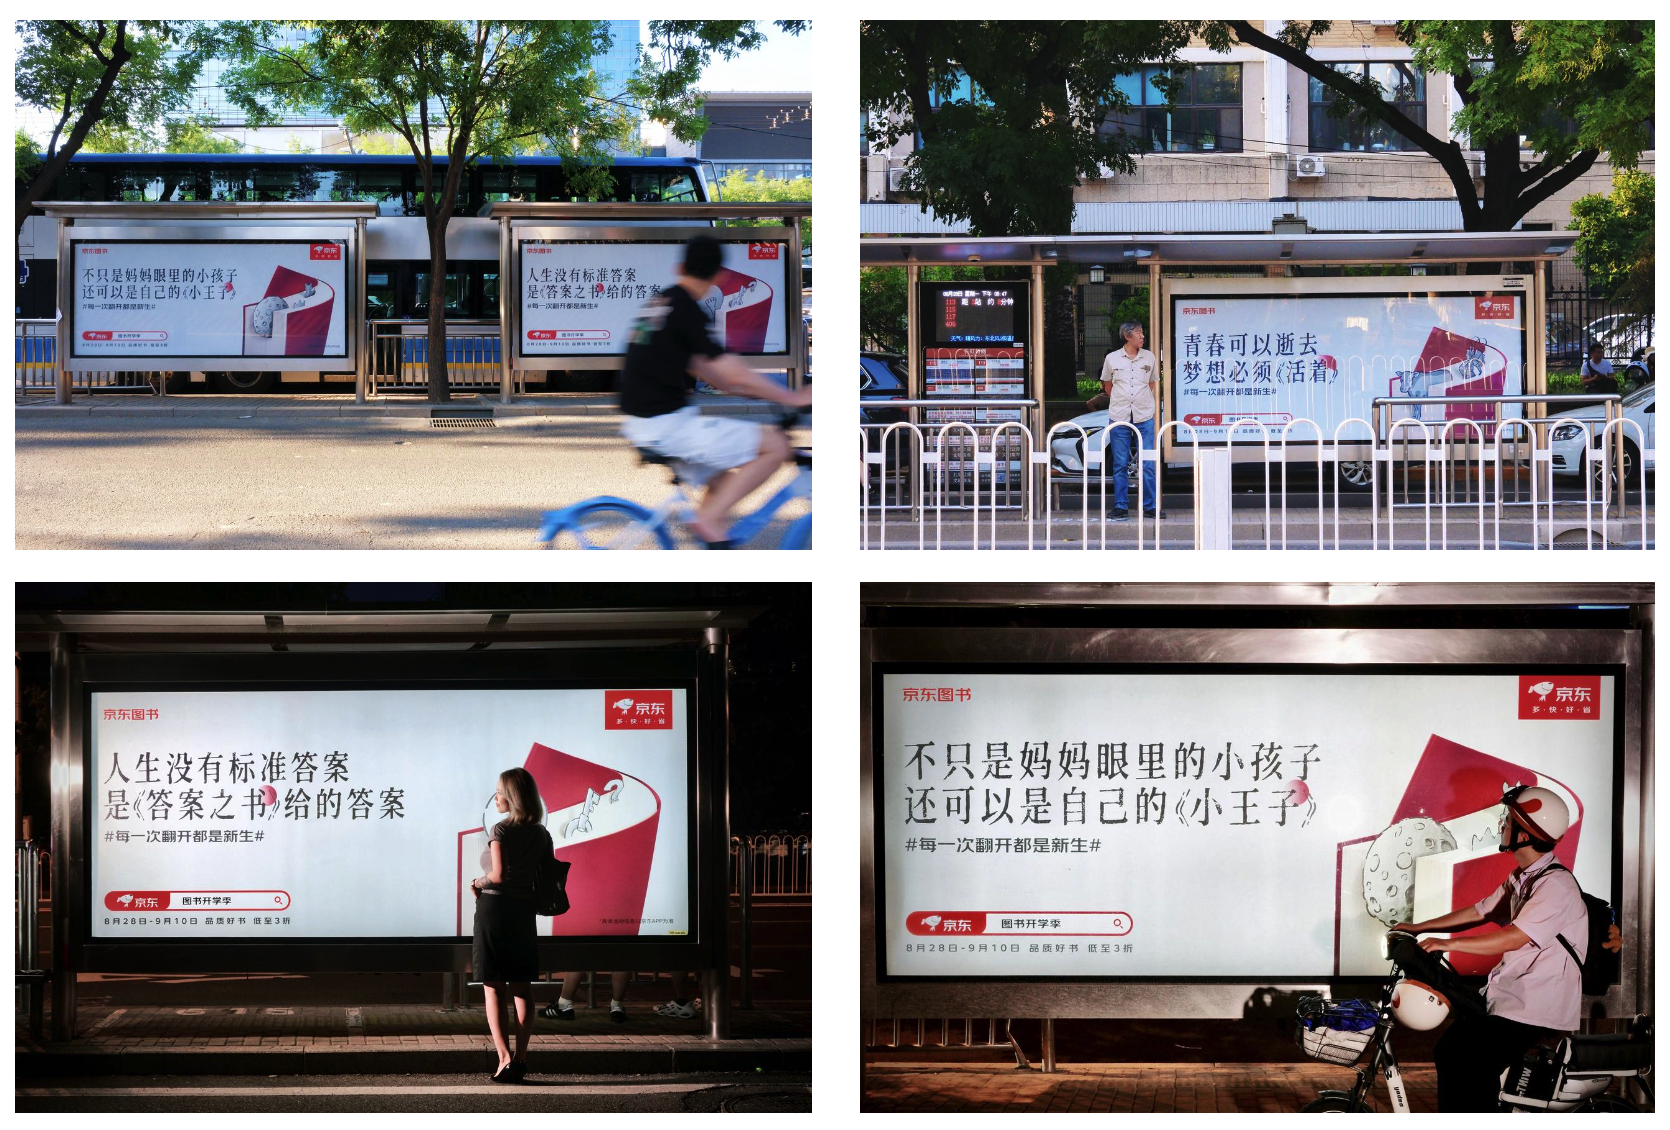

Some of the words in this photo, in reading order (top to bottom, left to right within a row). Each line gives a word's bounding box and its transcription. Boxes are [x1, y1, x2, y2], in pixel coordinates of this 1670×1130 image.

[82, 268, 238, 283] 不只是妈妈眼里的小孩子
[527, 267, 637, 283] 人生没有标准答案
[82, 284, 236, 300] 还可以是自己的《小王子》
[527, 284, 661, 300] 是《答案之书》给的答案
[987, 298, 995, 306] 约
[1492, 303, 1510, 311] 京东
[1182, 307, 1215, 315] 京东图书
[1183, 333, 1318, 357] 青春可以逝去
[1183, 360, 1339, 385] 梦想必须《活着》
[902, 687, 972, 702] 京东图书
[1556, 687, 1592, 702] 京东
[103, 708, 159, 721] 京东图书
[636, 703, 665, 715] 京东
[103, 751, 350, 785] 人生没有标准答案
[904, 741, 1321, 781] 不只是妈妈眼里的小孩子
[103, 787, 406, 821] 是《答案之书》给的答案
[904, 785, 1317, 828] 还可以是自己的《小王子》
[104, 829, 265, 843] #每一次翻开都是新生#
[905, 837, 1102, 853] #每一次翻开都是新生#
[134, 897, 159, 908] 京东
[182, 896, 232, 906] 图书开学季
[104, 917, 199, 925] 8月28日-9月10日
[205, 917, 247, 925] 品质好书
[253, 917, 291, 925] 低至3折
[943, 920, 972, 932] 京东
[1001, 919, 1061, 929] 图书开学季
[906, 943, 1020, 953] 8月28日-9月10日
[1029, 943, 1079, 953] 品质好书
[1087, 943, 1133, 953] 低至3折
